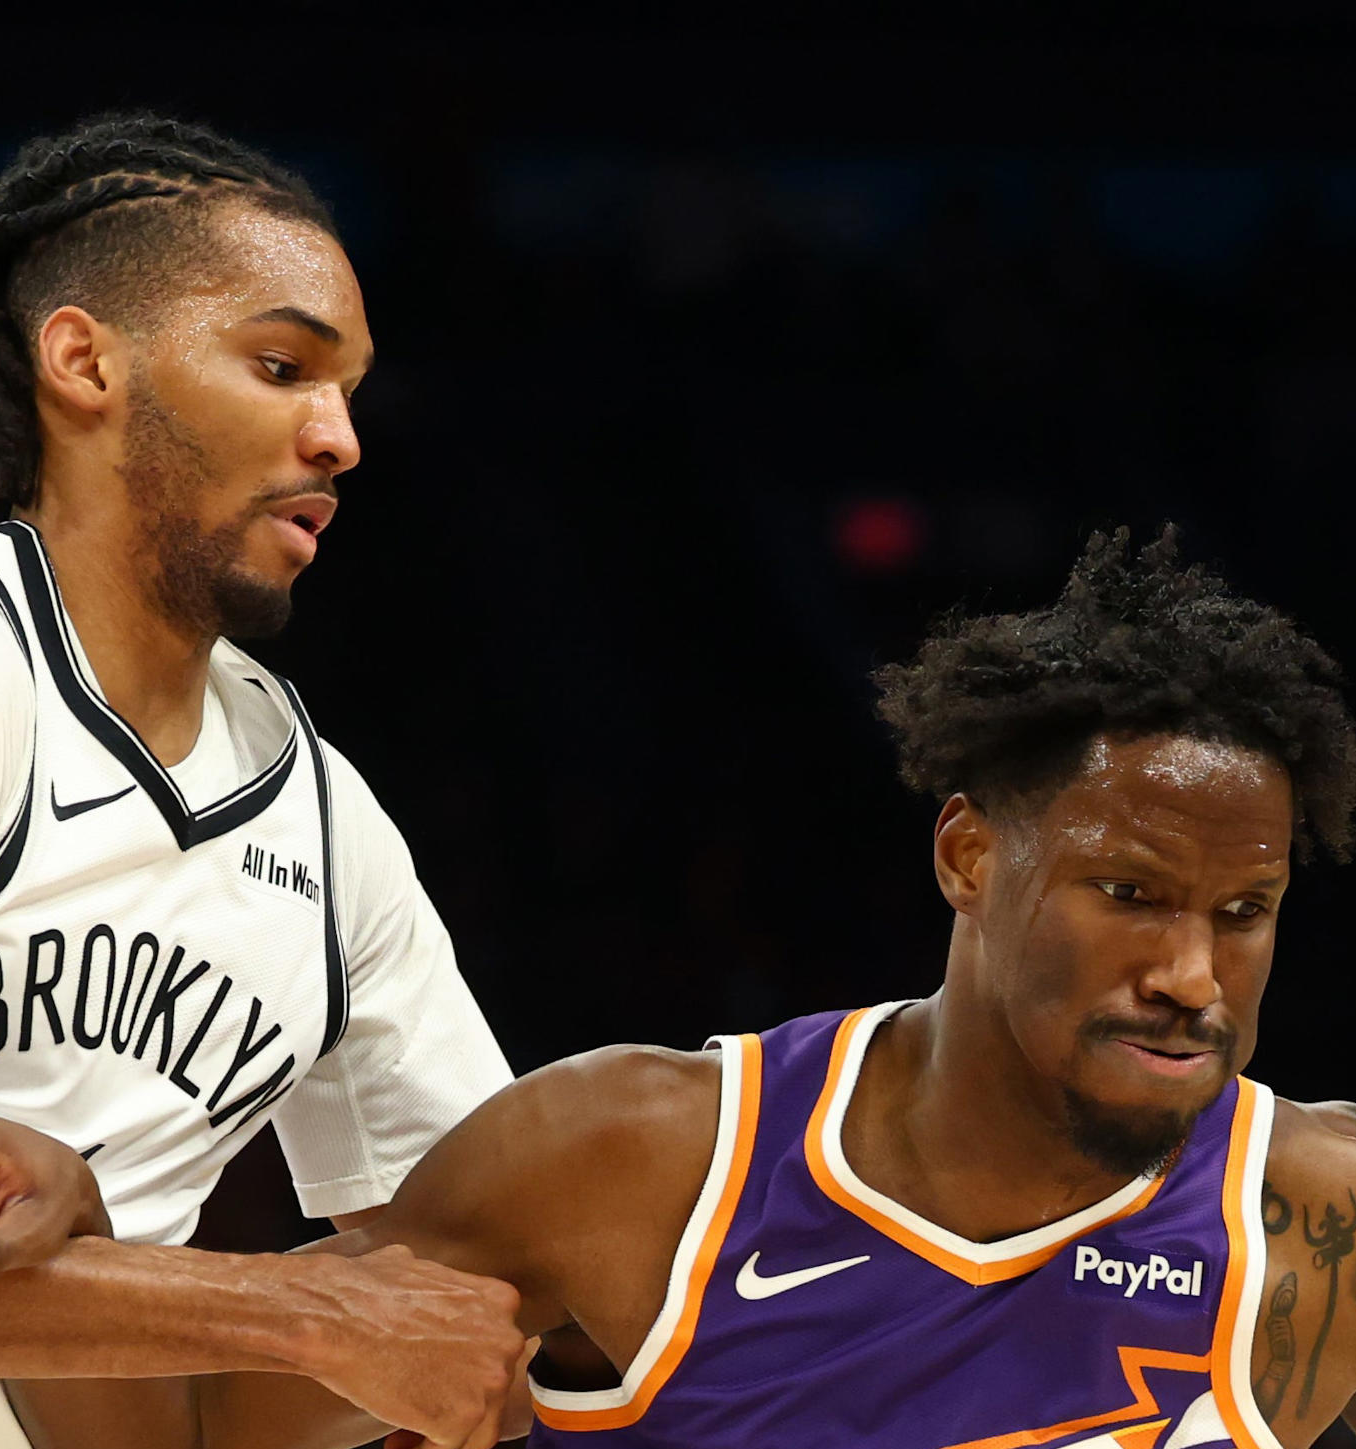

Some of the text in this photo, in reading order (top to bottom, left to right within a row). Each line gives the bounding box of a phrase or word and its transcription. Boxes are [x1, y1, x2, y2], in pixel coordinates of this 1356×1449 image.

[241, 843, 320, 905] All In Won
[1074, 1245, 1204, 1298] PayPal
